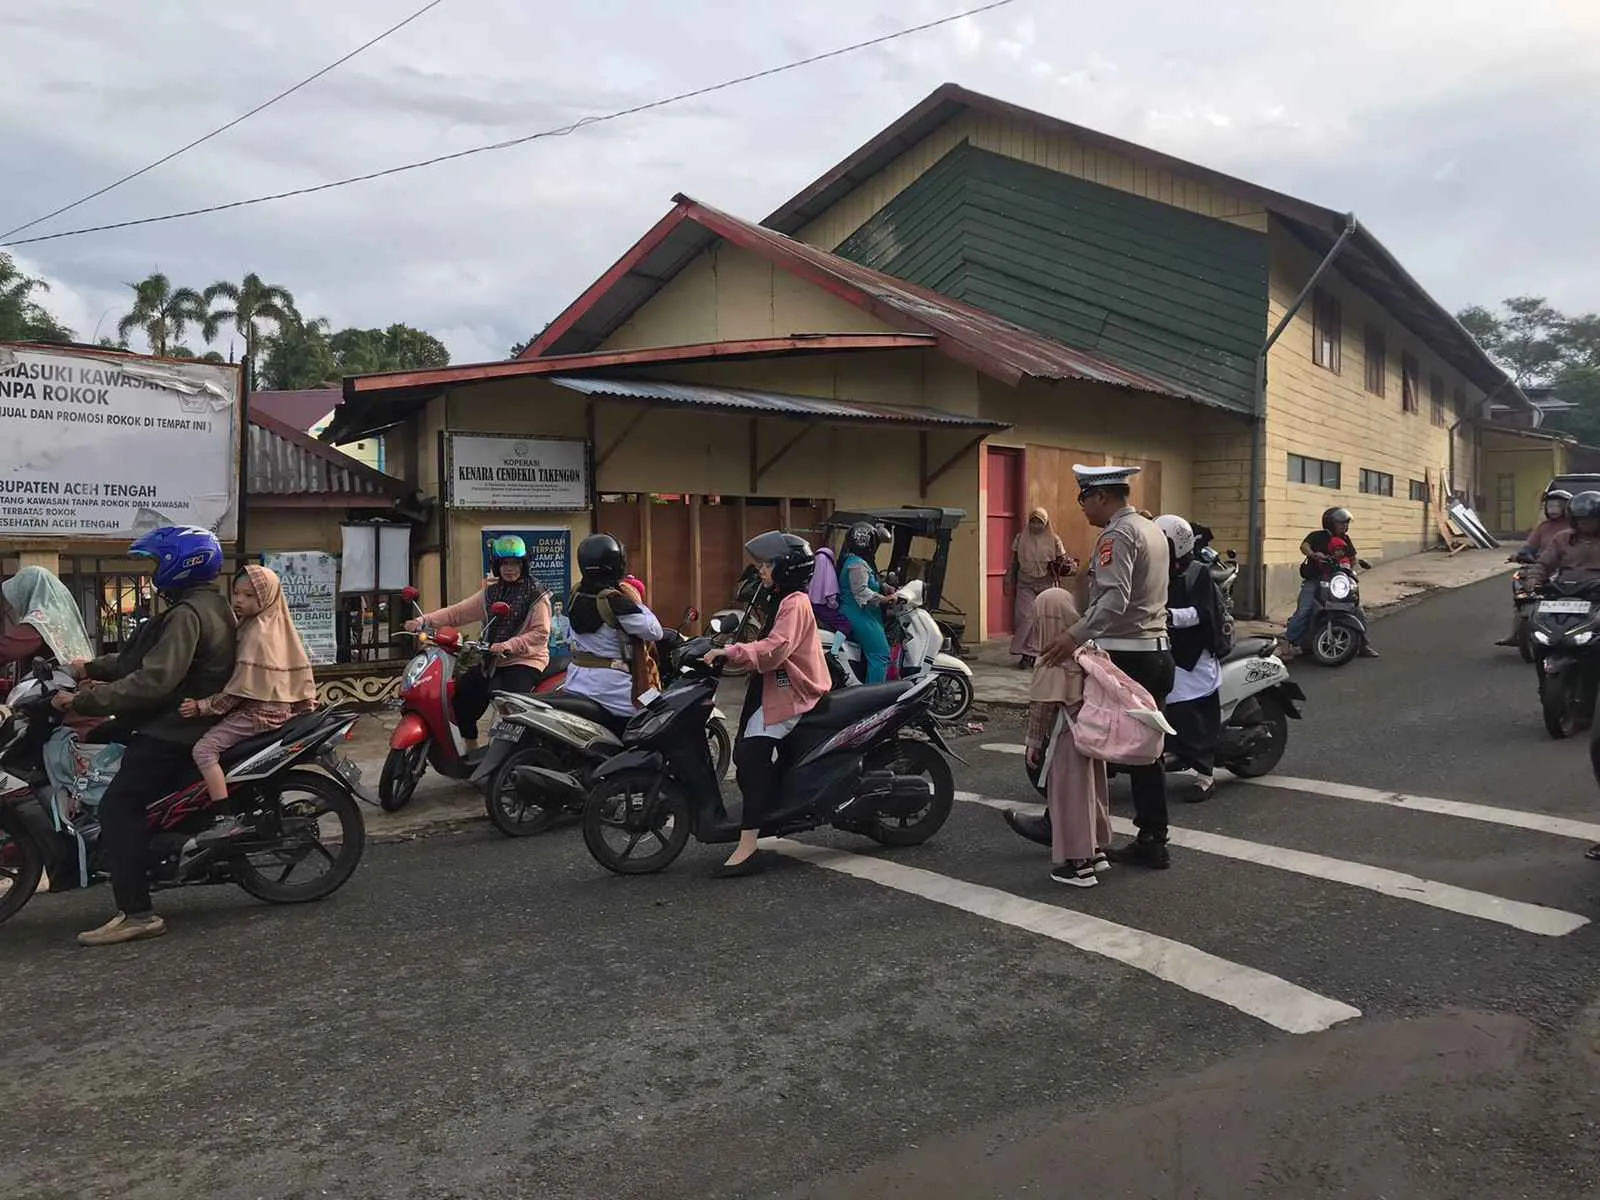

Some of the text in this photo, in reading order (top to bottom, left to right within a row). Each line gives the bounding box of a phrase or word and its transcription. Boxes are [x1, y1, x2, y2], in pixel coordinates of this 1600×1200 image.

[80, 368, 168, 391] KAWASA
[43, 384, 110, 405] ROKOK
[0, 406, 27, 418] JUAL
[31, 408, 53, 420] DAN
[57, 410, 104, 424] PROMOSI
[106, 415, 141, 427] ROKOK
[144, 417, 154, 427] DI
[157, 418, 191, 430] TEMPAT
[193, 420, 206, 431] INI
[503, 459, 541, 467] KOPERASI
[459, 466, 581, 483] KENARA CENDEKIA TAKENGON
[0, 480, 157, 498] BUPATEN ACEH TENGAH
[27, 497, 69, 506] KAWASAN
[71, 498, 99, 507] TANPA
[101, 499, 130, 508] ROKOK
[132, 500, 149, 508] DAN
[151, 501, 190, 509] KAWASAN
[2, 507, 77, 516] TERBATAS ROKOK
[52, 518, 77, 528] ACEH
[80, 519, 120, 529] TENGAH
[304, 612, 332, 621] BARU
